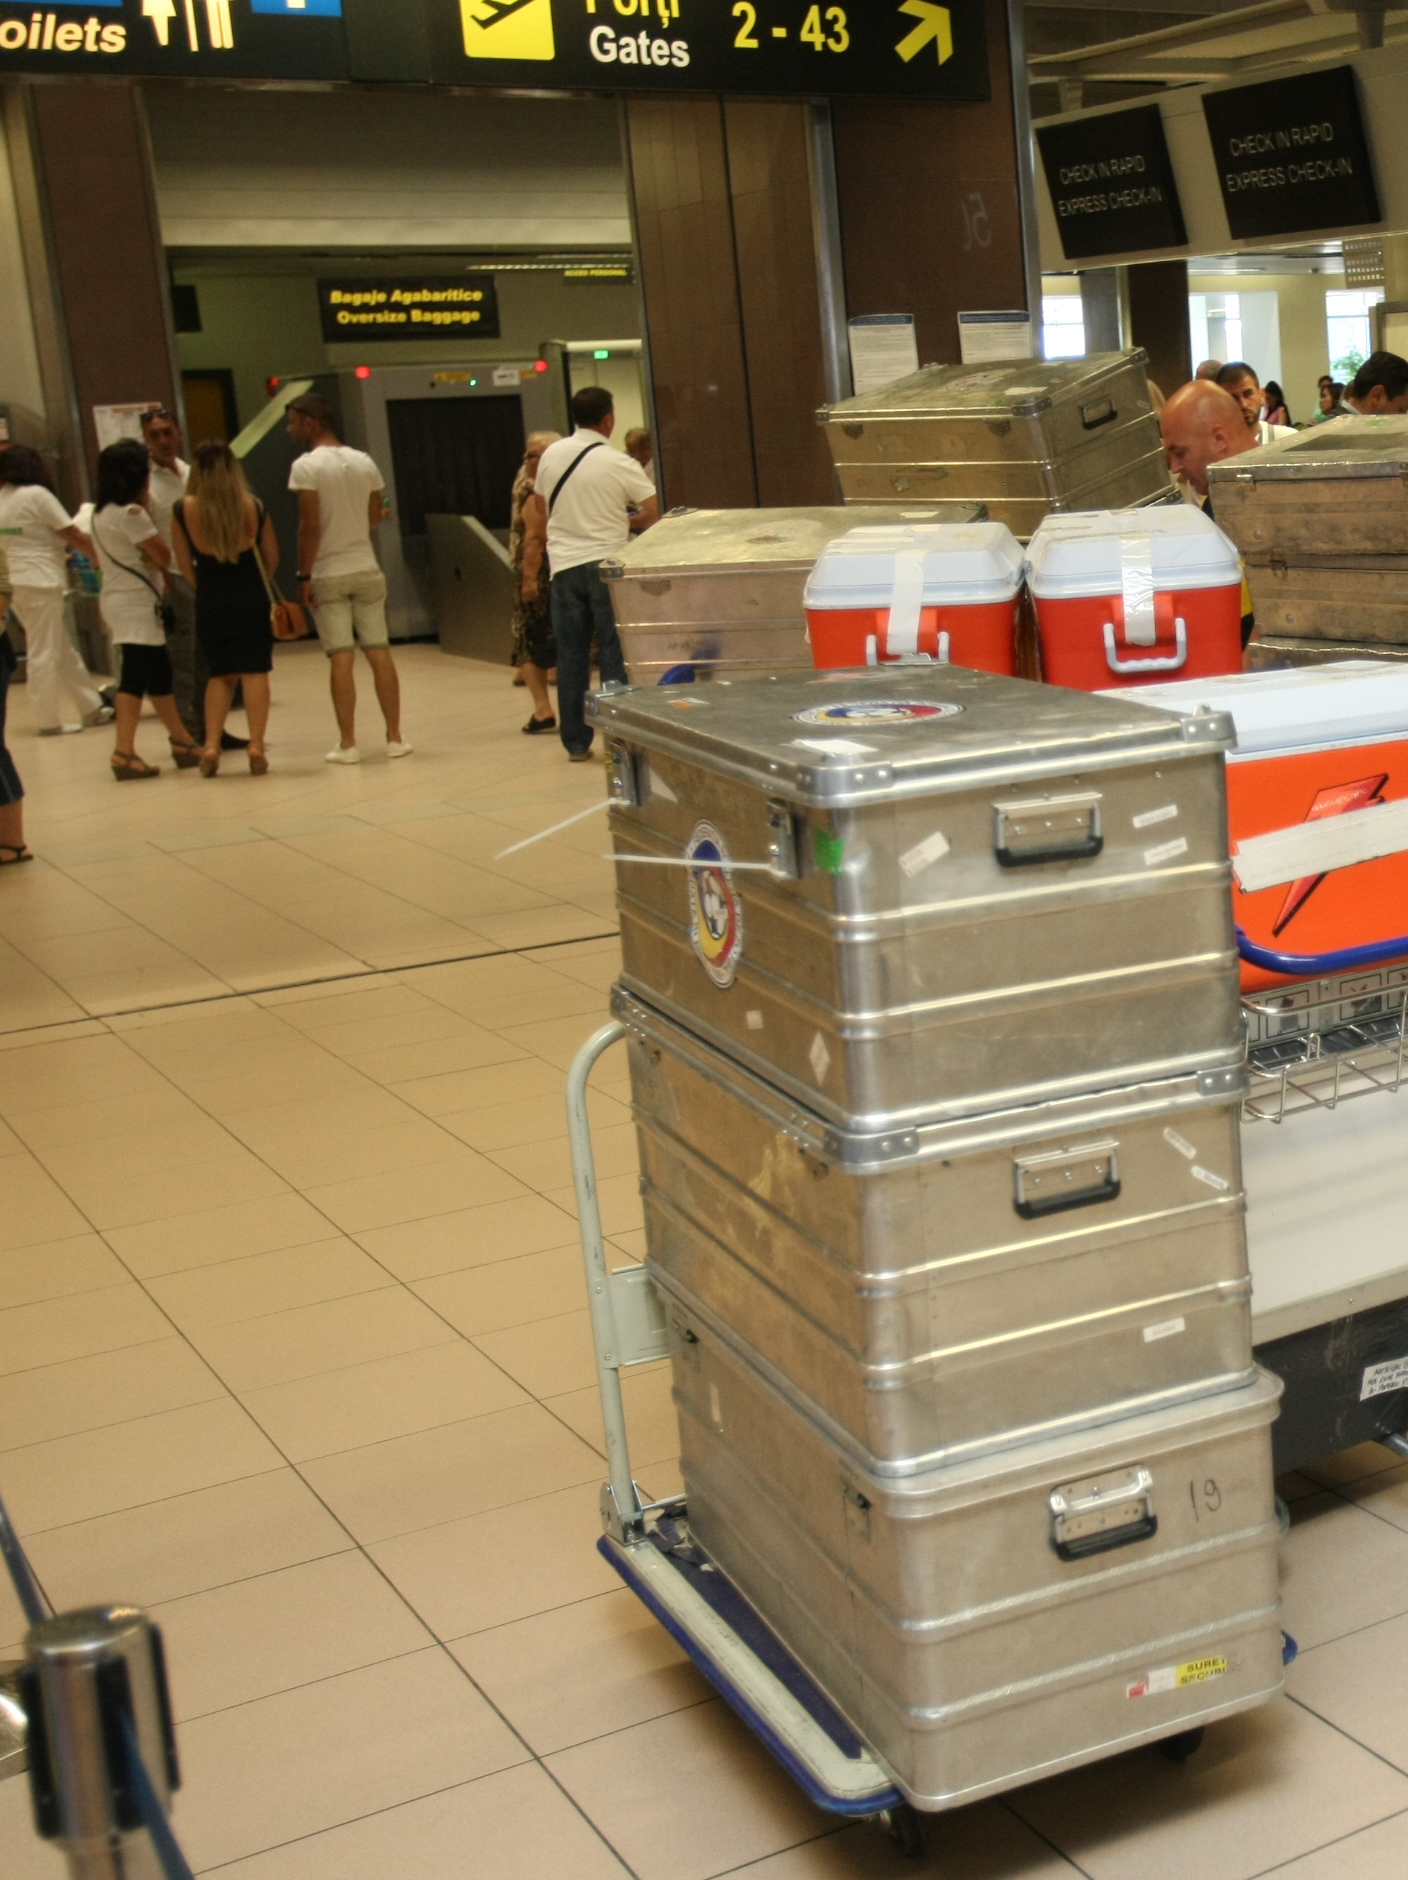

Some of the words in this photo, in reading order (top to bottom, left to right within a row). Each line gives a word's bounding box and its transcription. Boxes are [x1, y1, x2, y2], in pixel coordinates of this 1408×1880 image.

[732, 1, 759, 48] 2
[800, 4, 850, 52] 43
[589, 25, 690, 67] Gates
[1229, 132, 1274, 156] CHECK
[1275, 130, 1290, 149] IN
[1291, 122, 1334, 146] RAPID
[1060, 164, 1098, 185] CHECK
[1110, 155, 1145, 175] RAPID
[1225, 167, 1286, 192] EXPRESS
[1287, 157, 1353, 183] CHECK-IN
[1058, 194, 1108, 217] EXPRESS
[1108, 187, 1162, 209] CHECK-IN
[330, 290, 387, 306] Bagaje
[390, 288, 483, 305] Agabaritice
[337, 310, 407, 324] Oversize
[410, 309, 480, 324] Baggage
[1190, 1479, 1222, 1521] 19
